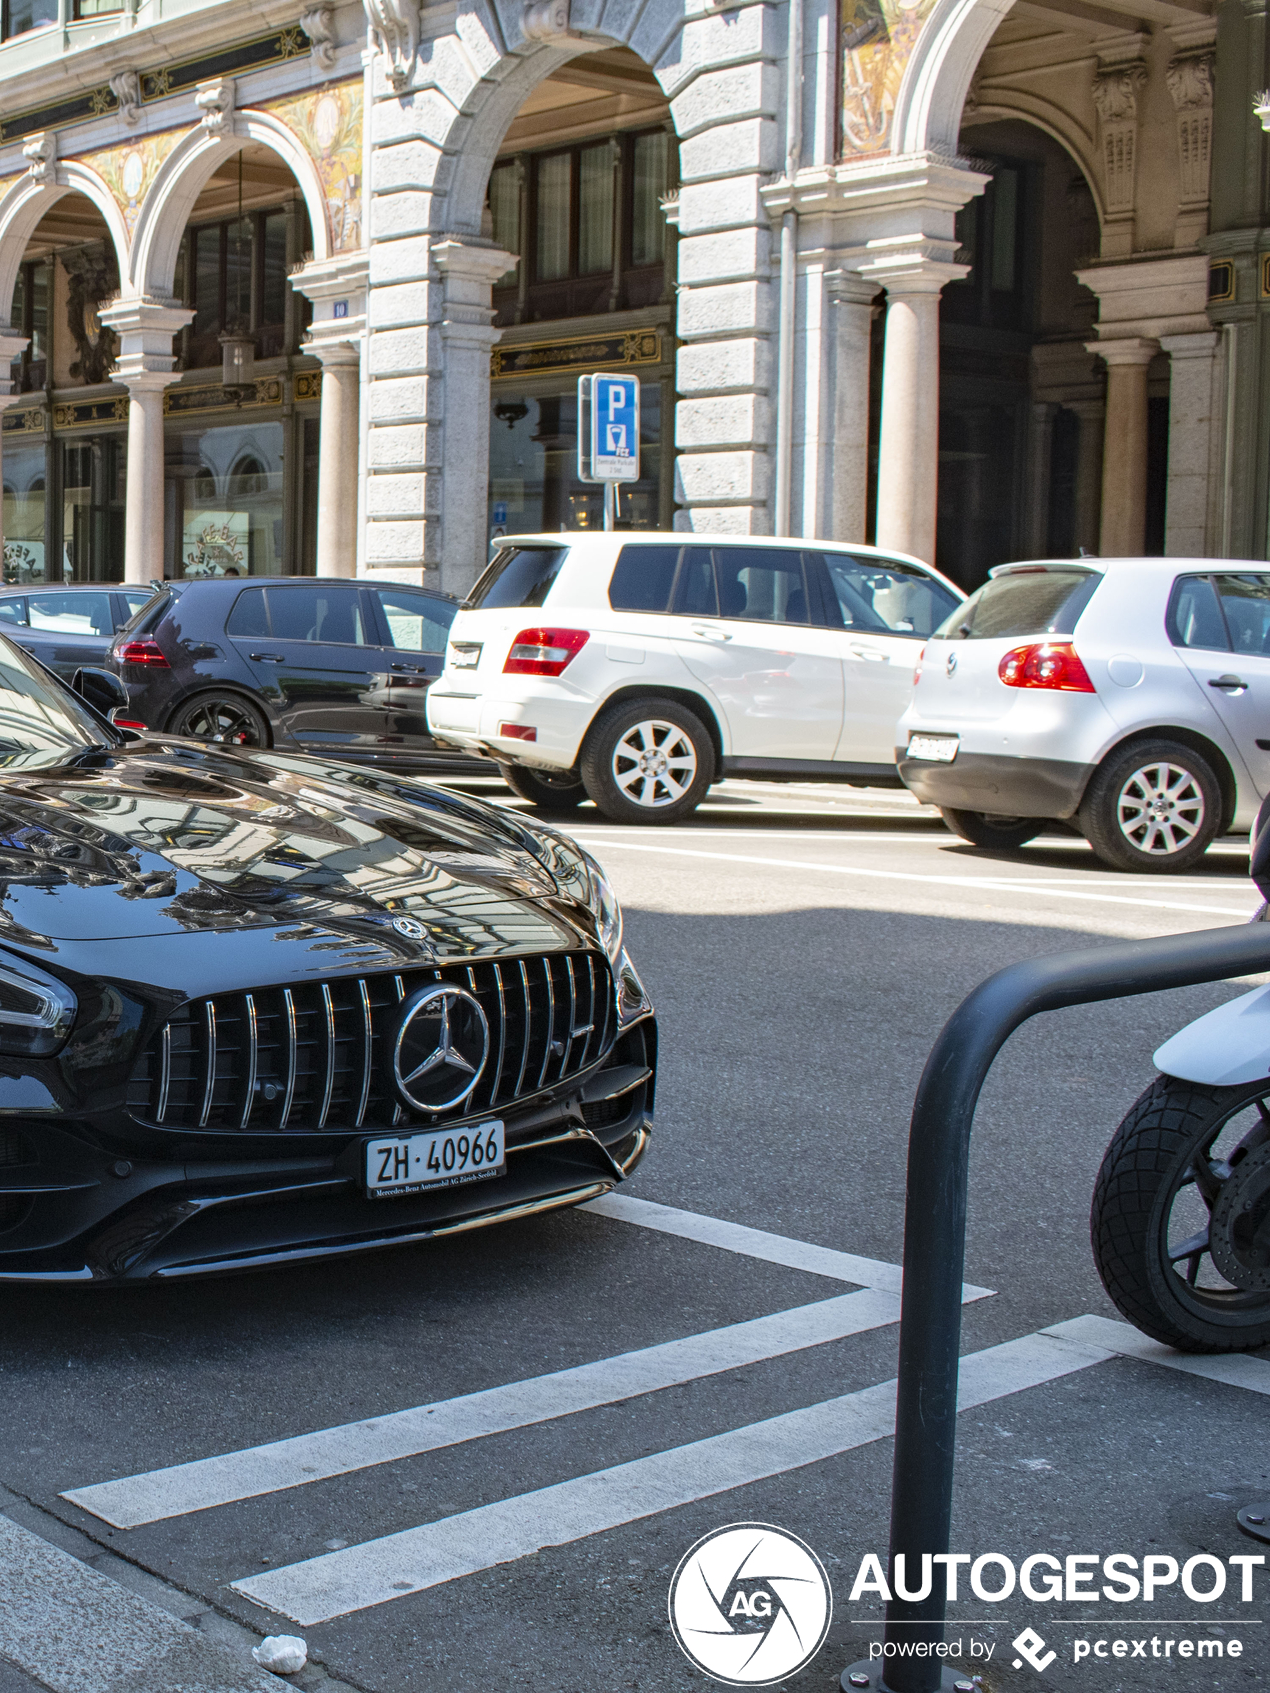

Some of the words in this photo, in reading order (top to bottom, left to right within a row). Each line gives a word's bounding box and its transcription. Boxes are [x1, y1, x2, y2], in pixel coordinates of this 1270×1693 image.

[609, 385, 626, 421] P
[376, 1185, 420, 1197] Mercedes-Benz
[420, 1179, 449, 1191] Automobil
[449, 1177, 459, 1186] AG
